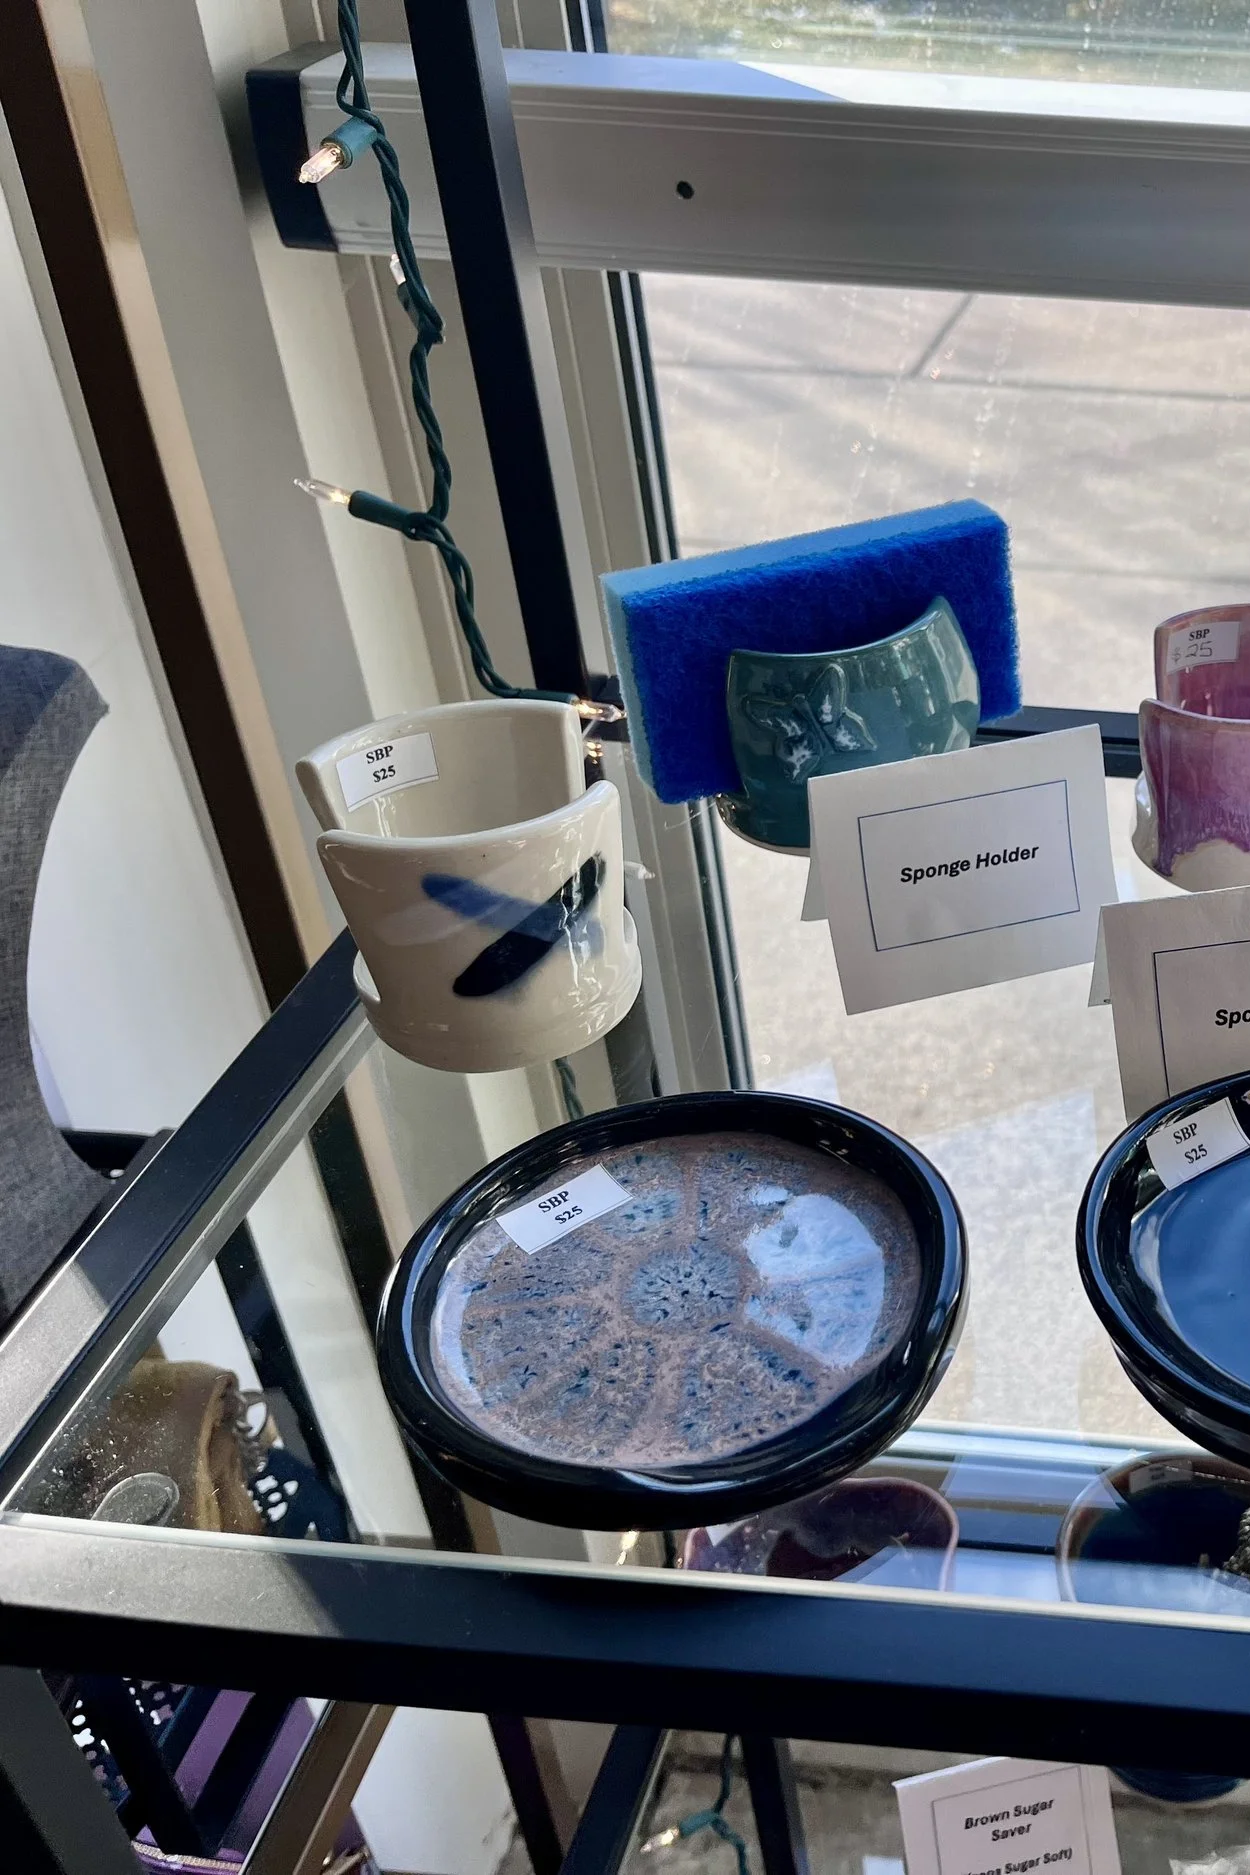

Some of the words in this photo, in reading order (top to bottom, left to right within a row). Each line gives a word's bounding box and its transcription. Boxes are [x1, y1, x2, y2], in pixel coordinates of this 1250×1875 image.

[1188, 628, 1210, 641] SBP
[366, 745, 393, 764] SBP
[373, 765, 396, 782] $25
[900, 859, 970, 884] Sponge
[975, 846, 1039, 869] Holder
[1173, 1122, 1197, 1145] SBP
[1184, 1144, 1208, 1164] $25
[538, 1190, 569, 1213] SBP
[554, 1205, 583, 1225] $25
[964, 1810, 1010, 1830] Brown
[1013, 1798, 1054, 1818] Sugar
[991, 1823, 1032, 1842] Saver
[1004, 1857, 1040, 1875] Sugar
[1043, 1847, 1073, 1864] Soft)
